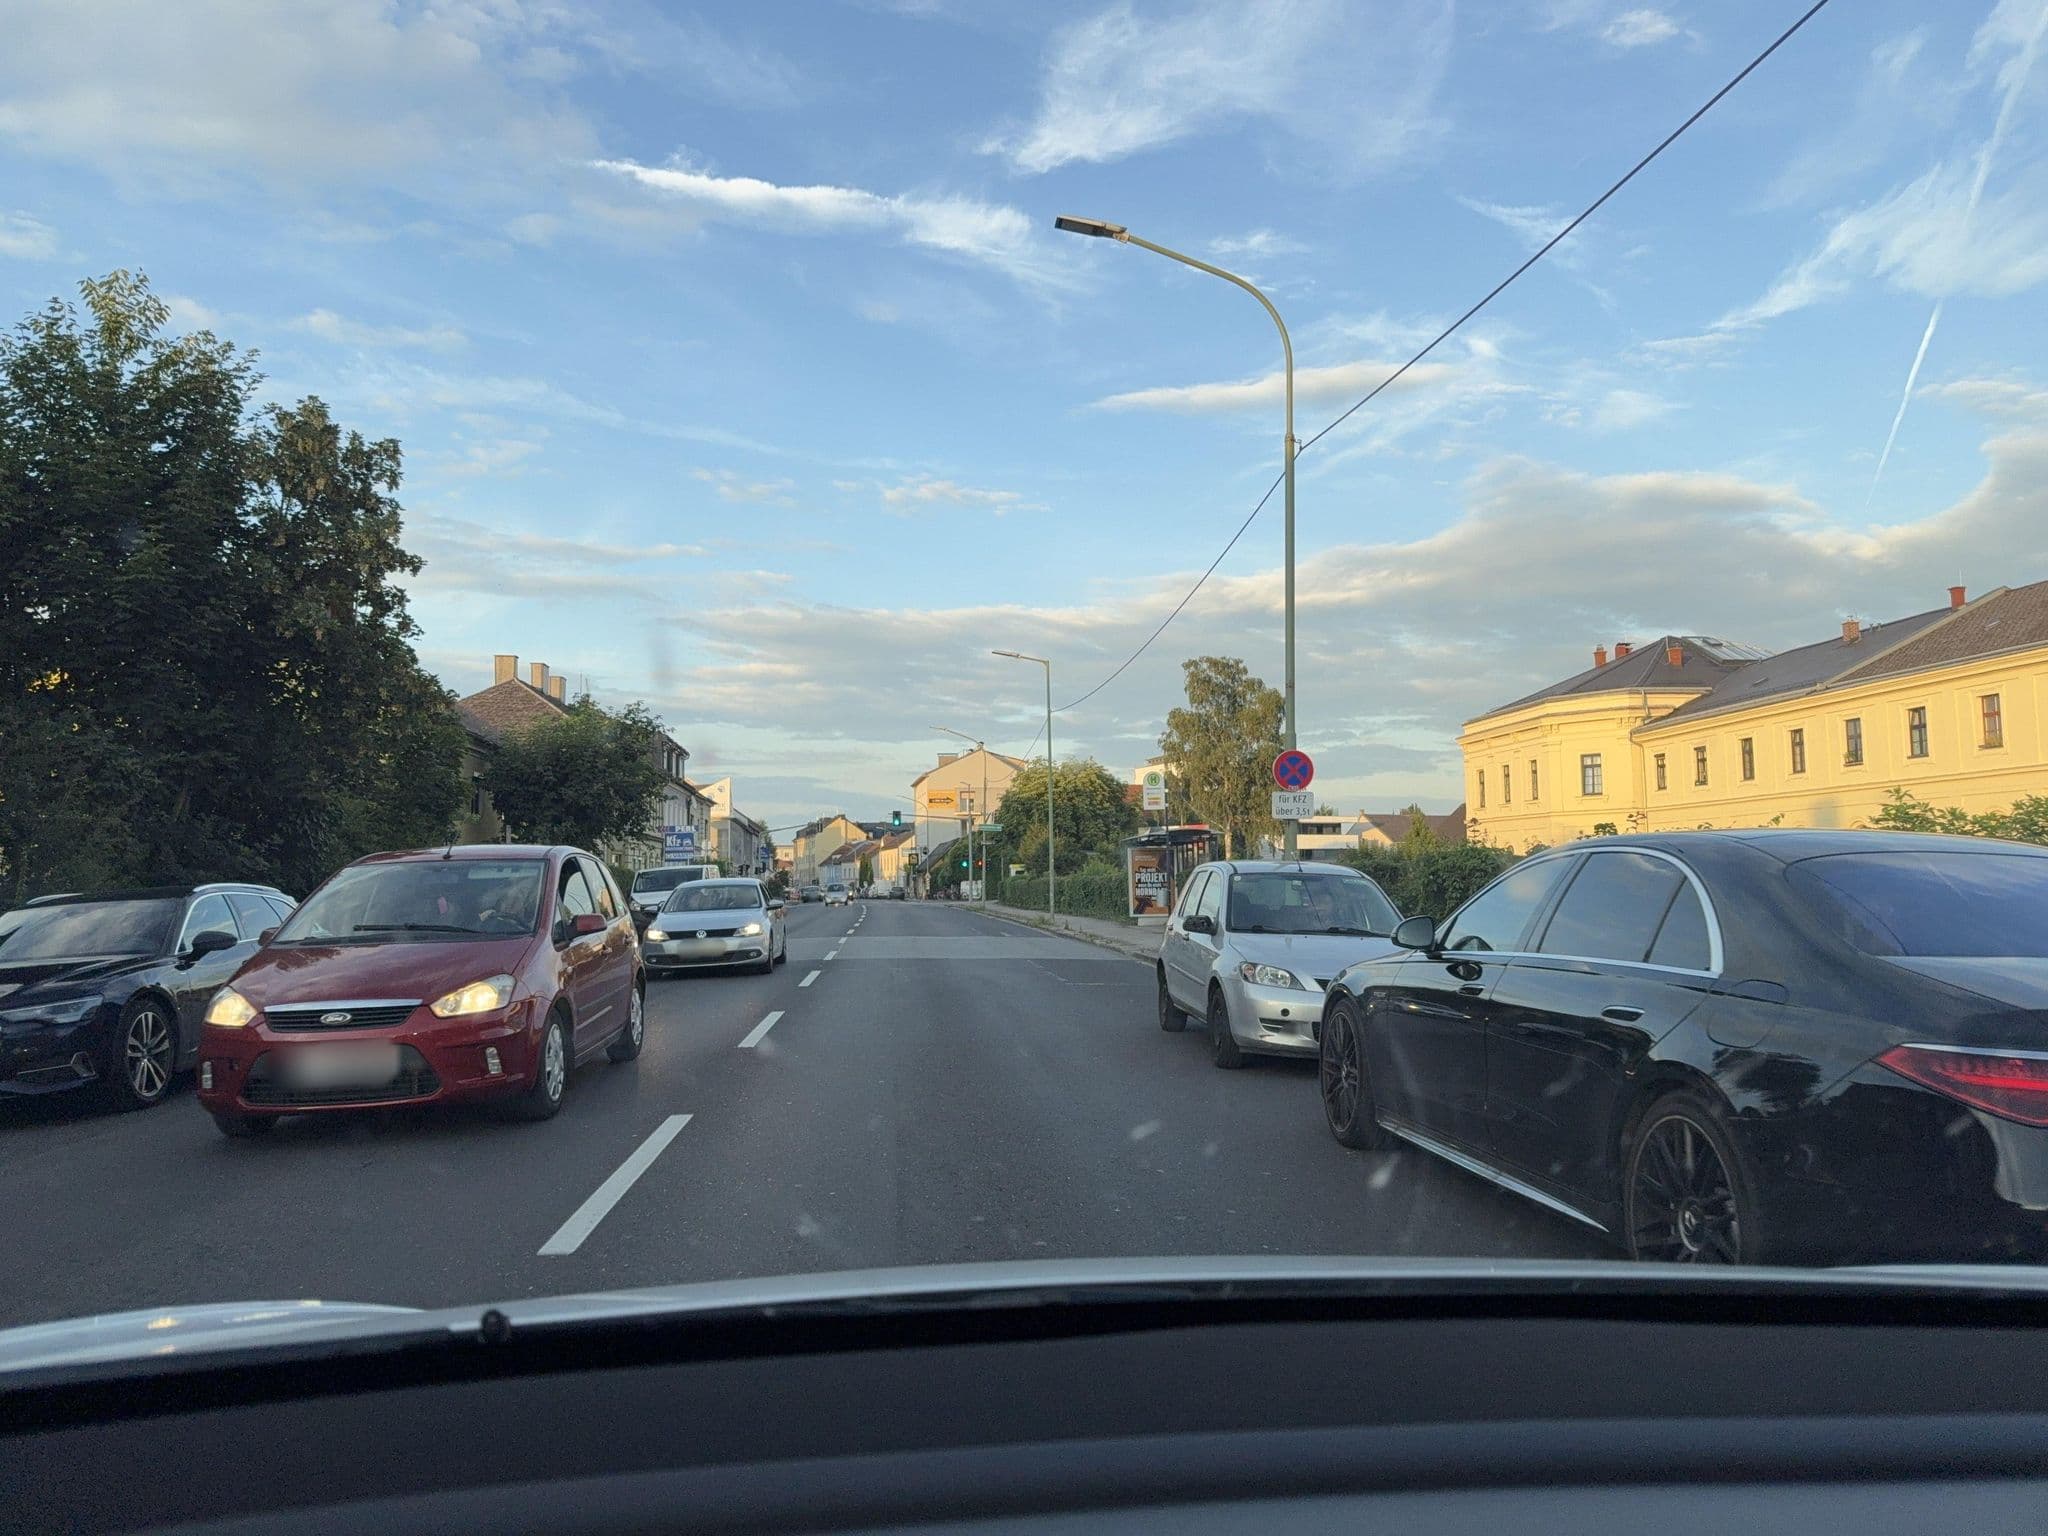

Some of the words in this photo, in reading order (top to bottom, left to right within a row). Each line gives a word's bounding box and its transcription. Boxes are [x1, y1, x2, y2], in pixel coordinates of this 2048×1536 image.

[1278, 794, 1289, 804] für
[1293, 794, 1307, 804] KFZ
[1276, 806, 1294, 816] über
[666, 834, 680, 846] Kfz
[1135, 872, 1168, 883] PROJEKT
